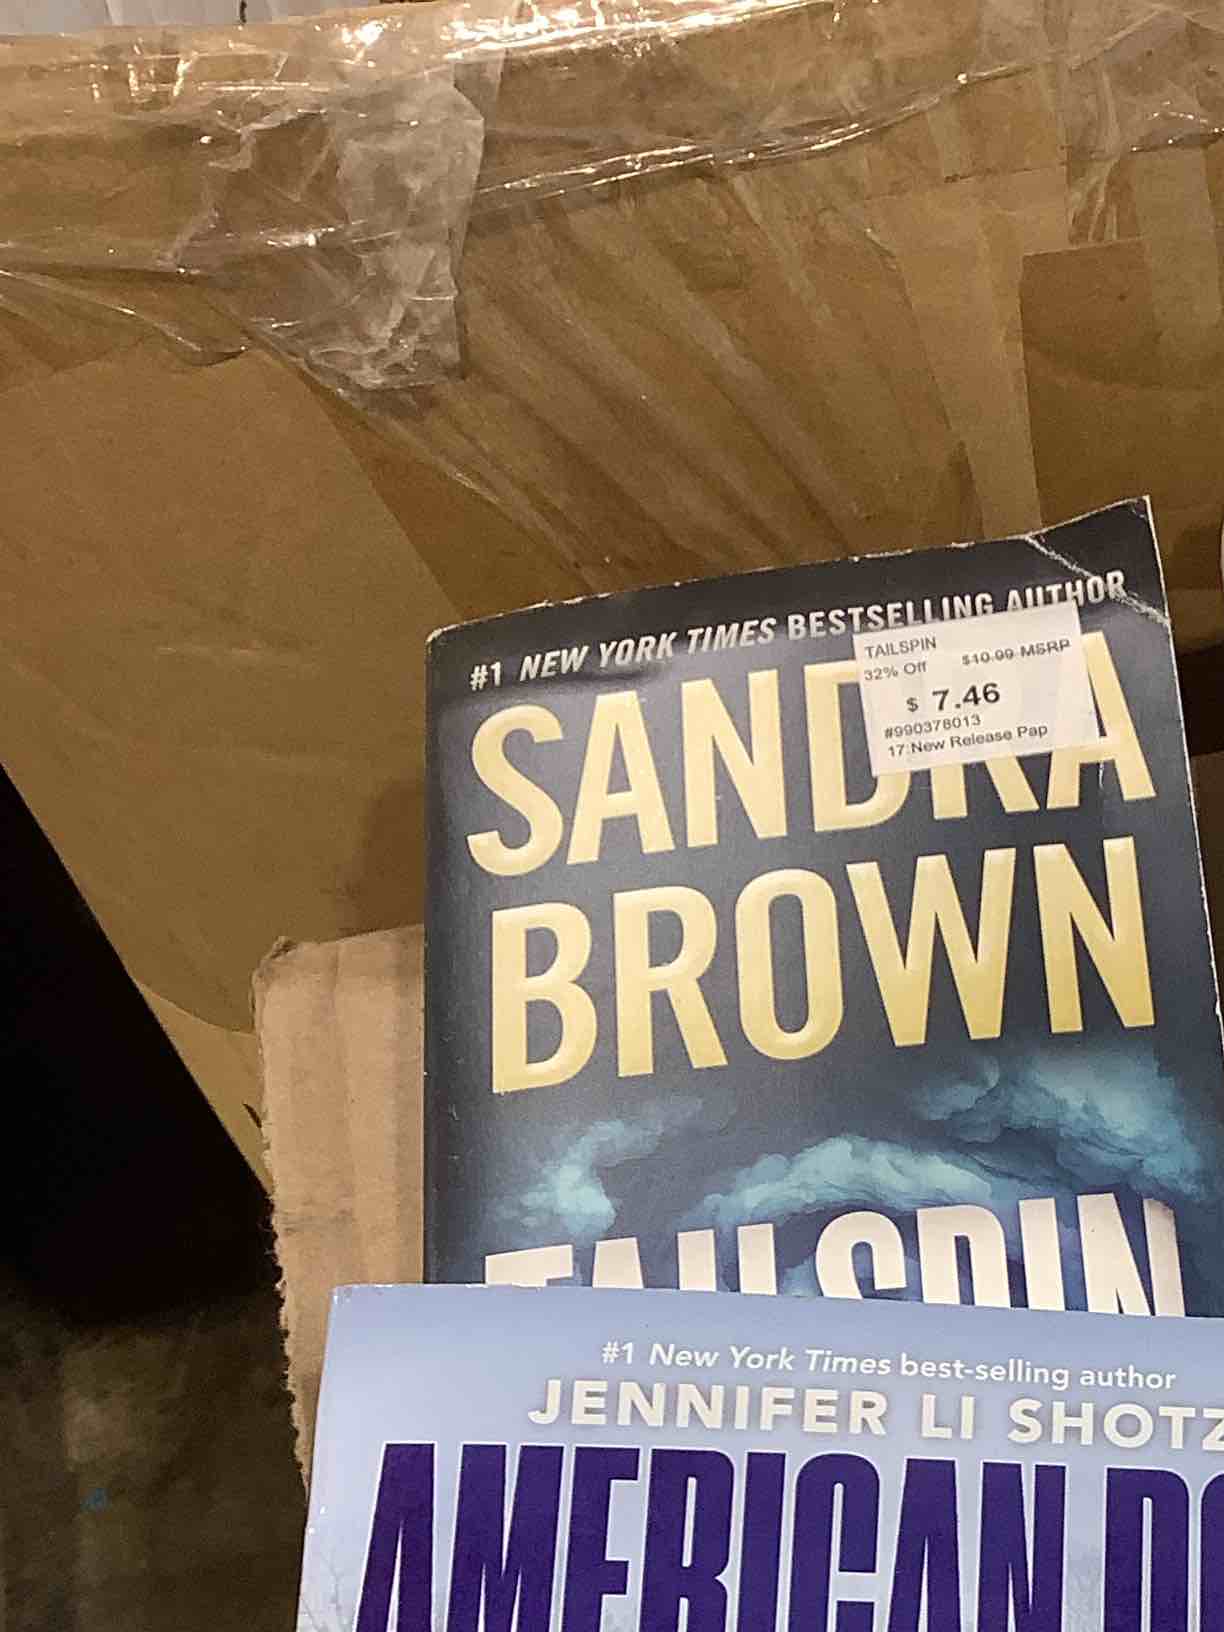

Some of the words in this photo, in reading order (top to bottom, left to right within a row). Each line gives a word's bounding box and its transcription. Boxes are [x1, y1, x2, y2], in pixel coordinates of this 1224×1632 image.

[470, 660, 502, 691] #1
[519, 645, 590, 682] NEW
[599, 631, 677, 668] YORK
[686, 616, 778, 655] TIMES
[788, 590, 993, 641] BESTSELLING
[1006, 569, 1126, 612] AUTHOR
[864, 636, 937, 659] TAILSPIN
[864, 667, 898, 681] 32%
[904, 660, 928, 676] Off
[962, 647, 1015, 666] $10.99
[1020, 638, 1072, 657] MSRP
[906, 697, 919, 713] $
[932, 682, 1001, 711] 7.46
[884, 714, 982, 740] #990378013
[950, 730, 1013, 747] Release
[1016, 722, 1049, 738] Pap
[489, 835, 1157, 1094] BROWN
[602, 1341, 634, 1364] #1
[649, 1344, 720, 1369] New
[727, 1345, 797, 1372] York
[803, 1349, 893, 1376] Times
[900, 1352, 1070, 1390] best-selling
[1079, 1365, 1176, 1389] author
[527, 1378, 888, 1435] JENNIFER
[920, 1393, 977, 1440] LI
